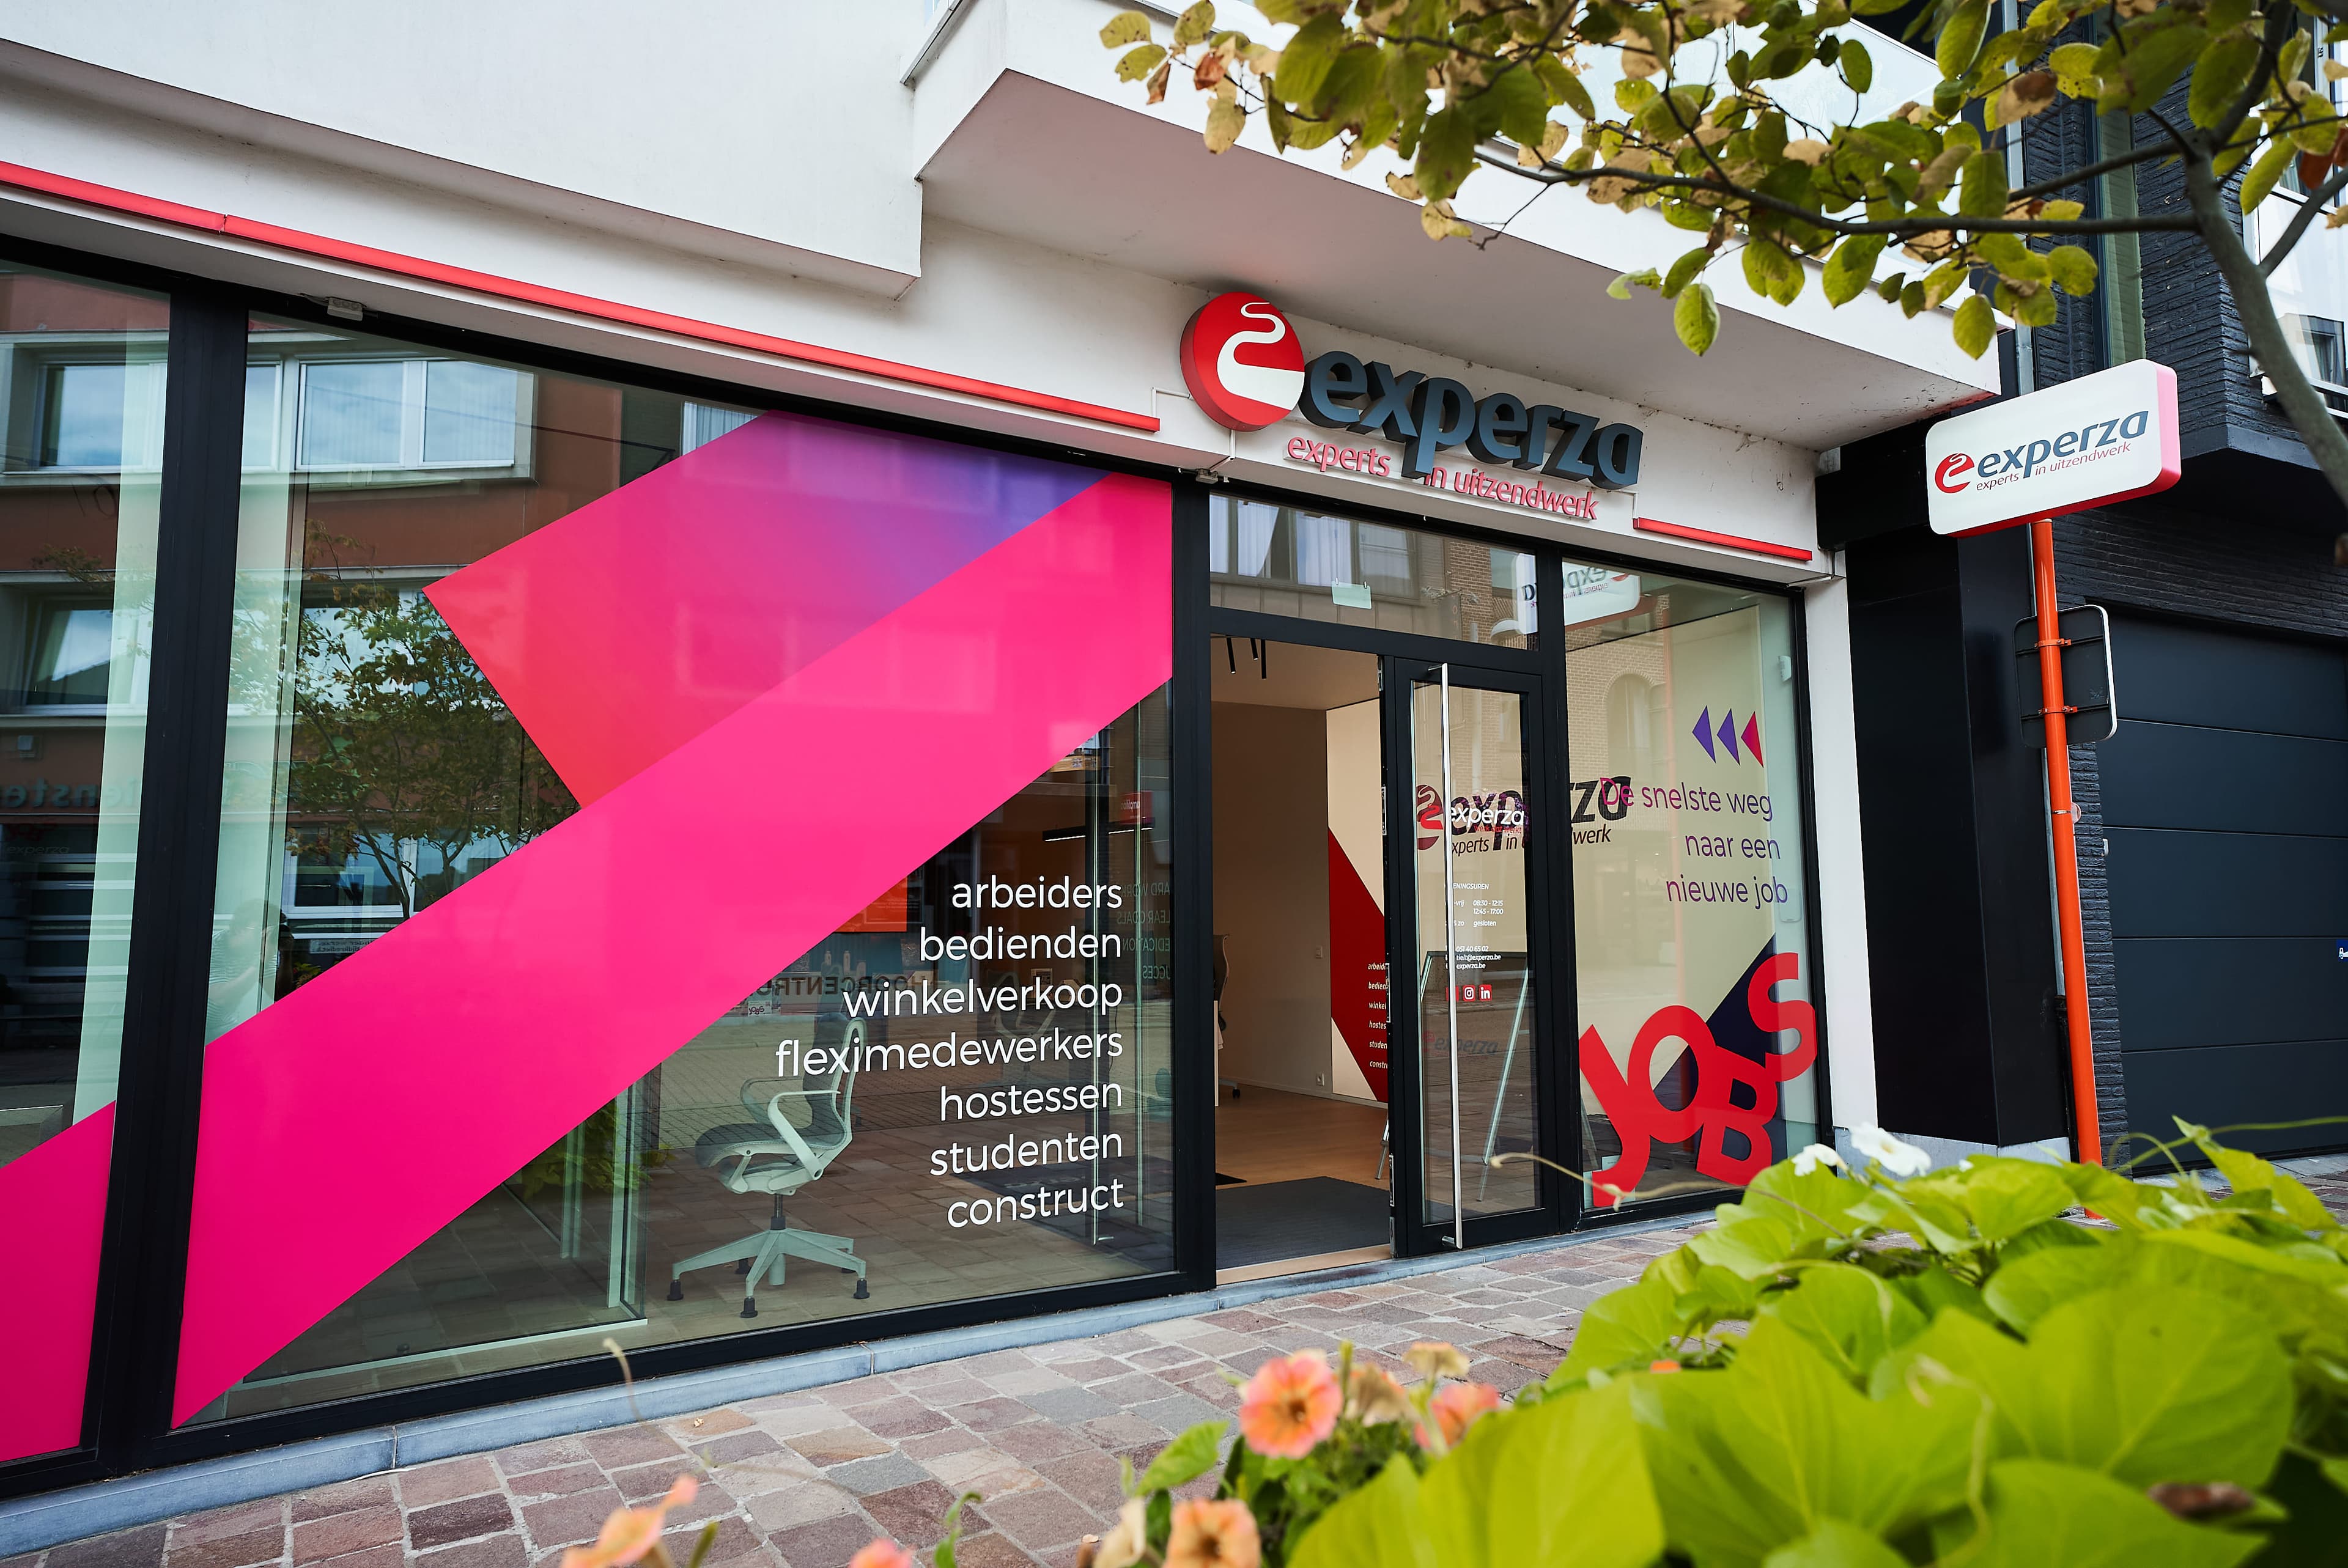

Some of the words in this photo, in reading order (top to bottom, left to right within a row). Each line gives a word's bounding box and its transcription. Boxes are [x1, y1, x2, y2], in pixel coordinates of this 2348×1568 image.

[1300, 351, 1644, 488] experza
[1976, 473, 2019, 491] experts
[2035, 465, 2047, 476] in
[2050, 442, 2132, 473] uitzendwerk
[1977, 411, 2149, 479] experza
[1287, 435, 1391, 477] experts
[1423, 465, 1446, 489] in
[1454, 466, 1600, 521] uitzendwerk
[1451, 807, 1524, 827] experza
[1600, 777, 1634, 806] De
[1642, 781, 1721, 814] snelste
[1726, 792, 1772, 823] weg
[1452, 837, 1490, 856] xperts
[1506, 834, 1518, 850] in
[1686, 833, 1733, 859] naar
[1741, 837, 1780, 860] een
[952, 874, 1123, 910] arbeiders
[1666, 874, 1748, 904] nieuwe
[1754, 876, 1788, 910] job
[920, 926, 1122, 962] bedienden
[843, 976, 1123, 1018] winkelverkoop
[775, 1031, 1123, 1078] fleximedewerkers
[940, 1081, 1122, 1122] hostessen
[1579, 952, 1817, 1207] JOBS
[929, 1132, 1123, 1177] studenten
[947, 1179, 1124, 1228] construct
